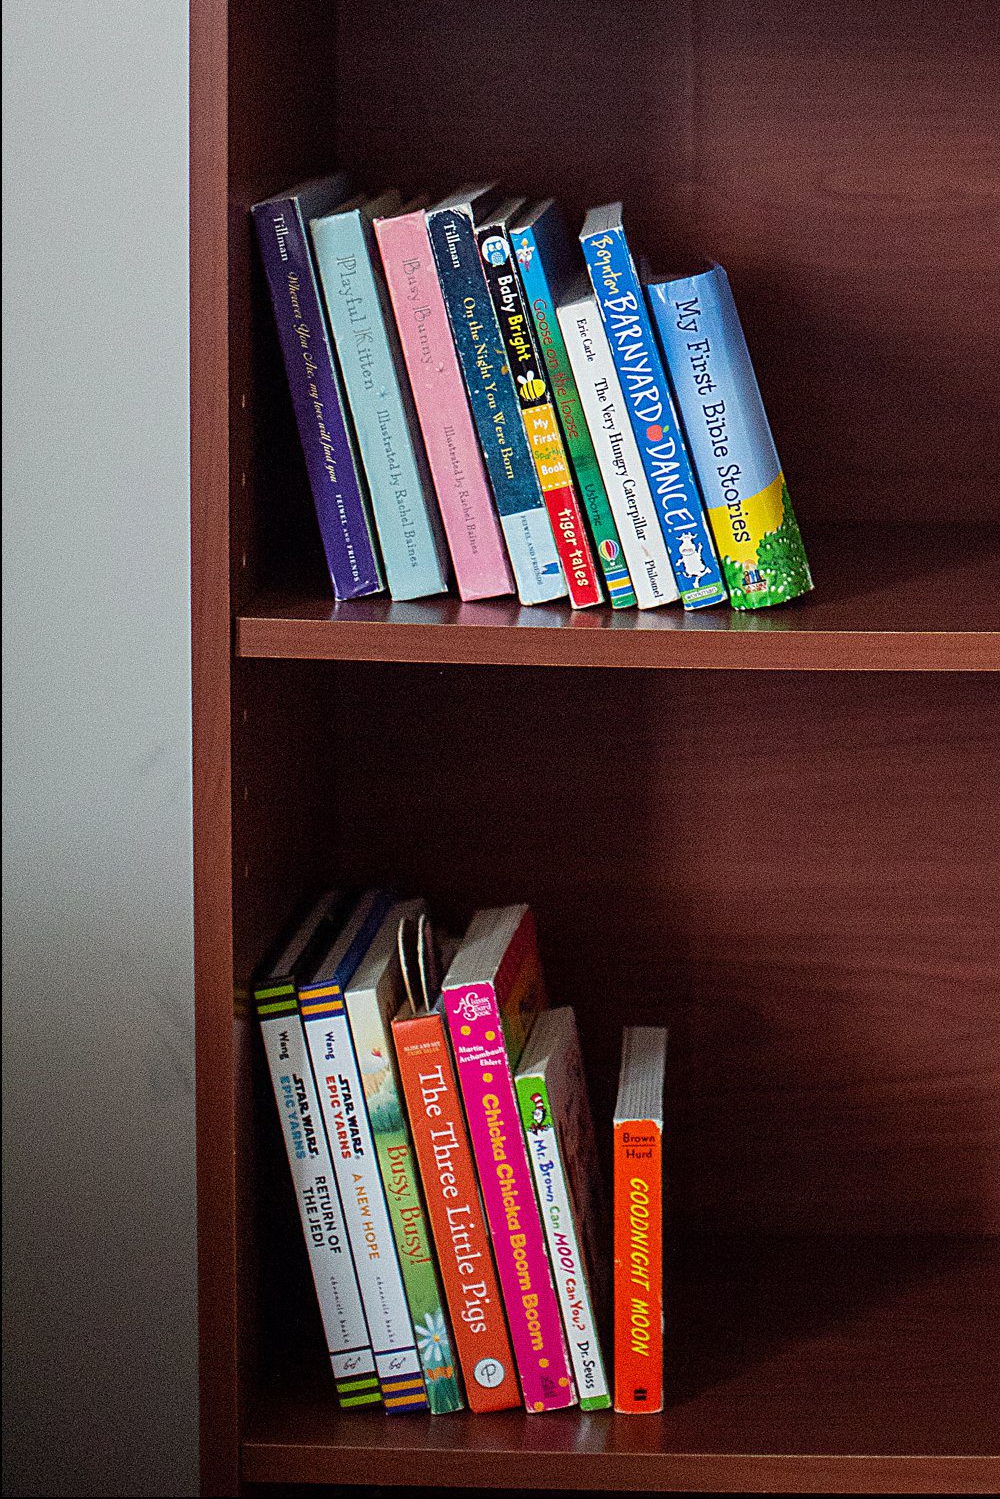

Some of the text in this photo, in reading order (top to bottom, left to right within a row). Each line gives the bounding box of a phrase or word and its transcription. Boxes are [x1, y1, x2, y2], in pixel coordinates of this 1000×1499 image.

[273, 214, 288, 261] Tillman
[444, 221, 461, 268] Tillman
[590, 235, 622, 296] Boynton
[336, 254, 375, 390] Playful Kitten
[402, 258, 434, 364] Busy Bunny
[497, 274, 532, 362] Baby Bright
[293, 323, 310, 349] You
[576, 318, 597, 363] Eric Carle
[309, 383, 318, 399] my
[463, 297, 515, 480] On the Night You Were Born
[533, 298, 580, 439] Goose on the loose
[313, 401, 324, 421] love
[318, 422, 331, 441] will
[533, 418, 549, 430] My
[603, 291, 693, 533] BARNYARD DANCE!
[675, 297, 752, 544] My First Bible Stories
[320, 440, 337, 465] find
[533, 433, 558, 446] First
[594, 378, 648, 541] The Very Hungry Caterpillar
[326, 463, 337, 483] you
[377, 410, 419, 567] Illustrated by Rachel Baines
[443, 425, 479, 555] Illustrated by Rachel Baines
[541, 464, 566, 476] Book
[584, 484, 602, 527] Usborne
[347, 545, 360, 582] FRIENDS
[557, 508, 590, 588] tiger tales
[644, 561, 664, 599] Philomel
[278, 1031, 290, 1061] Wang
[324, 1031, 336, 1061] Wang
[458, 1045, 484, 1054] Martin
[459, 1046, 505, 1063] Archambault
[480, 1058, 502, 1067] Ehlert
[292, 1073, 320, 1157] STAR WARS
[337, 1073, 365, 1157] STAR WARS
[418, 1065, 449, 1119] The
[280, 1076, 308, 1160] EPIC YARNS
[325, 1075, 353, 1160] EPIC YARNS
[622, 1132, 656, 1143] Brown
[430, 1121, 461, 1199] Three
[533, 1139, 548, 1157] Mr.
[625, 1148, 653, 1159] Hurd
[386, 1144, 431, 1265] Busy, Busy!
[540, 1160, 555, 1202] Brown
[302, 1188, 326, 1248] THE JEDI
[314, 1175, 342, 1254] RETURN OF
[351, 1173, 380, 1260] A NEW HOPE
[481, 1093, 545, 1352] Chicka Chicka Boom Boom
[549, 1205, 561, 1230] Can
[446, 1204, 483, 1276] Little
[553, 1232, 576, 1275] MOO!
[630, 1176, 651, 1357] GOODNIGHT MOON
[461, 1281, 490, 1334] Pigs
[577, 1341, 595, 1389] Dr. Seuss
